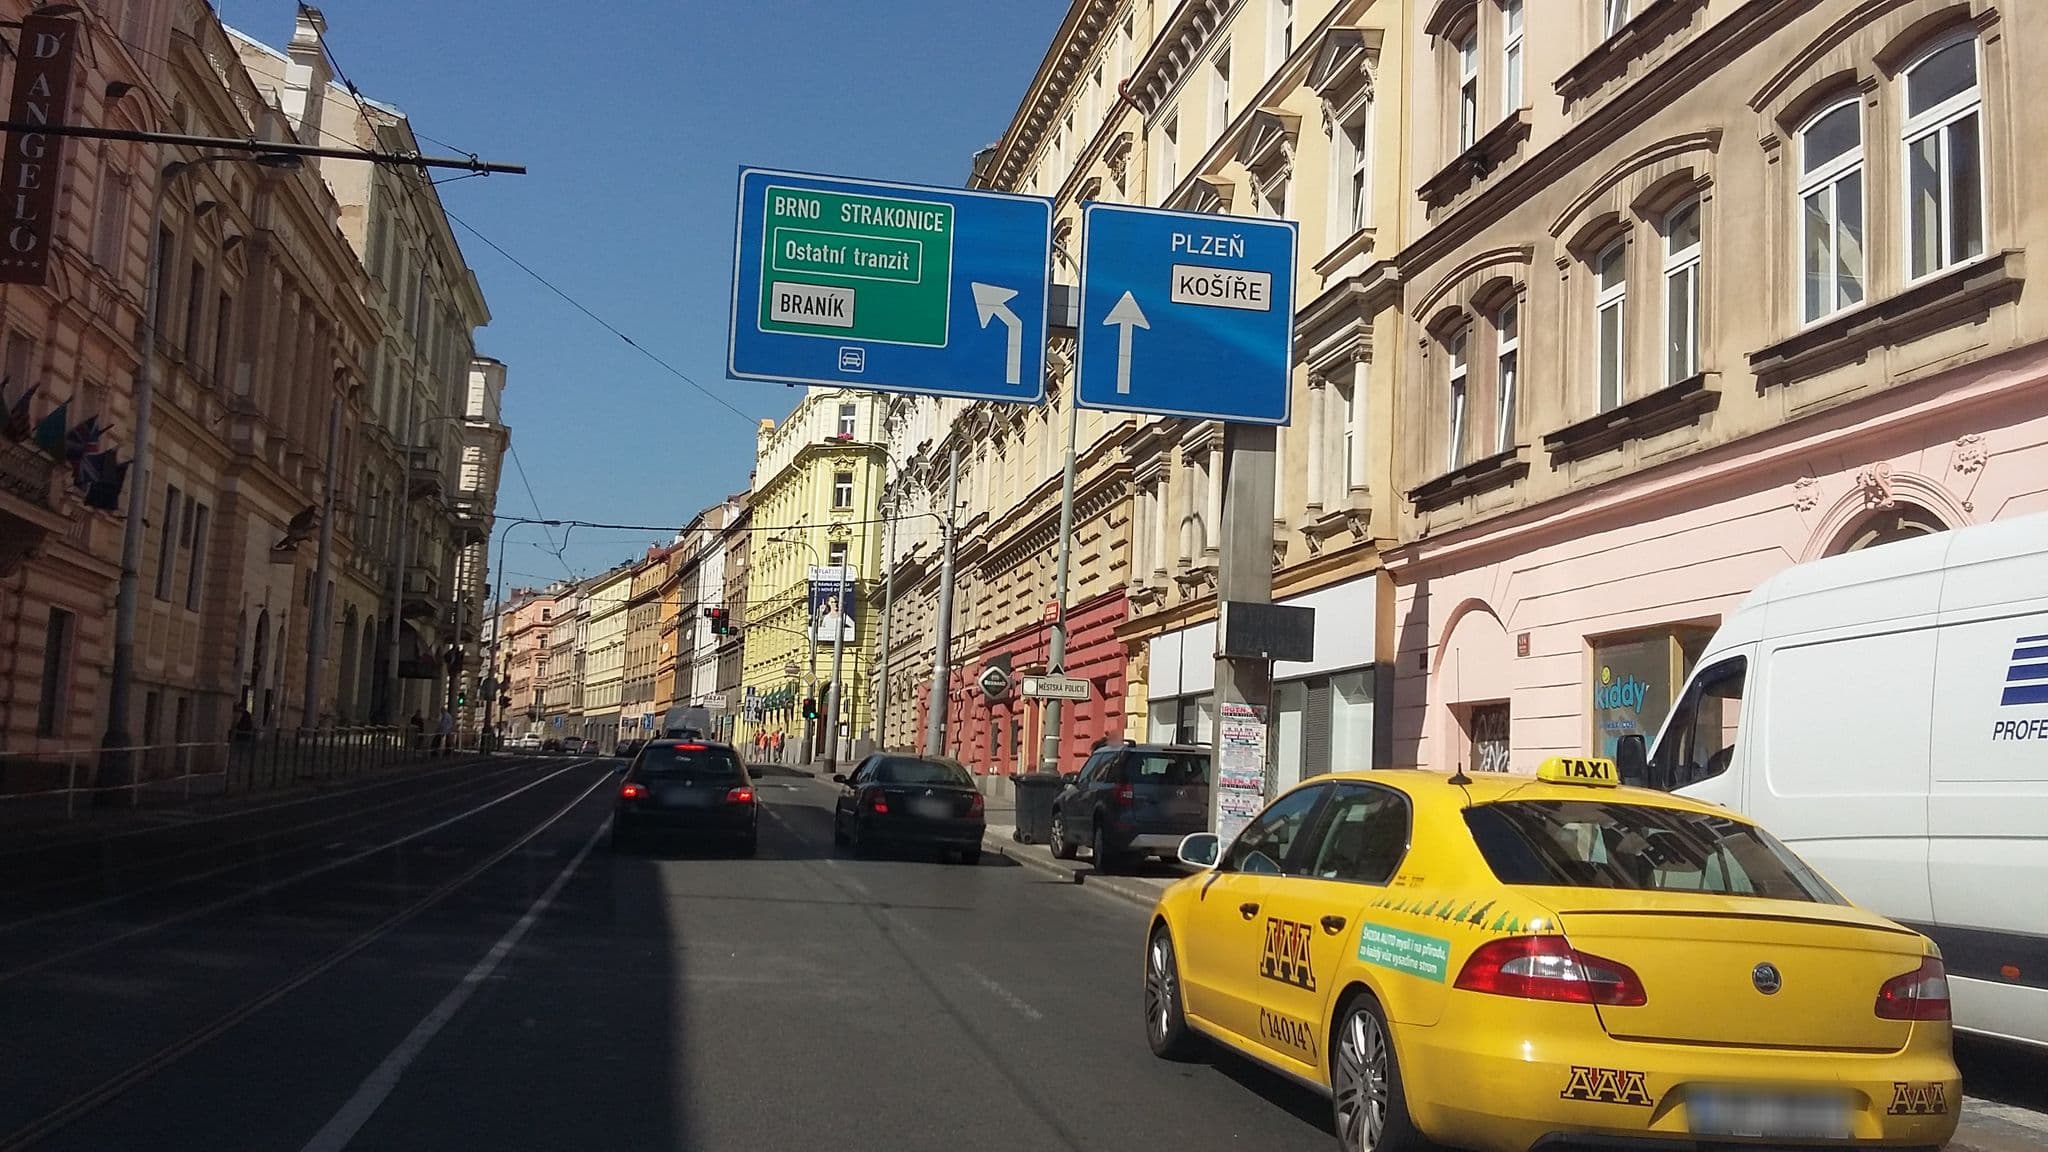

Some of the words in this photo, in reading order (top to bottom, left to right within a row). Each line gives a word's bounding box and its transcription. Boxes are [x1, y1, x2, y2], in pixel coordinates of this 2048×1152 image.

[774, 196, 820, 220] BRNO
[840, 203, 944, 233] STRAKONICE
[785, 239, 846, 266] Ostatní
[853, 247, 910, 272] tranzit
[1172, 232, 1246, 259] PLZEŇ
[780, 290, 845, 318] BRANÍK
[1180, 272, 1262, 302] KOŠÍŘE
[1064, 684, 1086, 693] POLICIE
[1595, 666, 1645, 714] kiddy
[1562, 759, 1609, 779] TAXI
[1260, 917, 1316, 992] AAA
[1266, 1012, 1308, 1051] 14014
[1560, 1065, 1653, 1107] AAA
[1887, 1081, 1948, 1116] AAA
